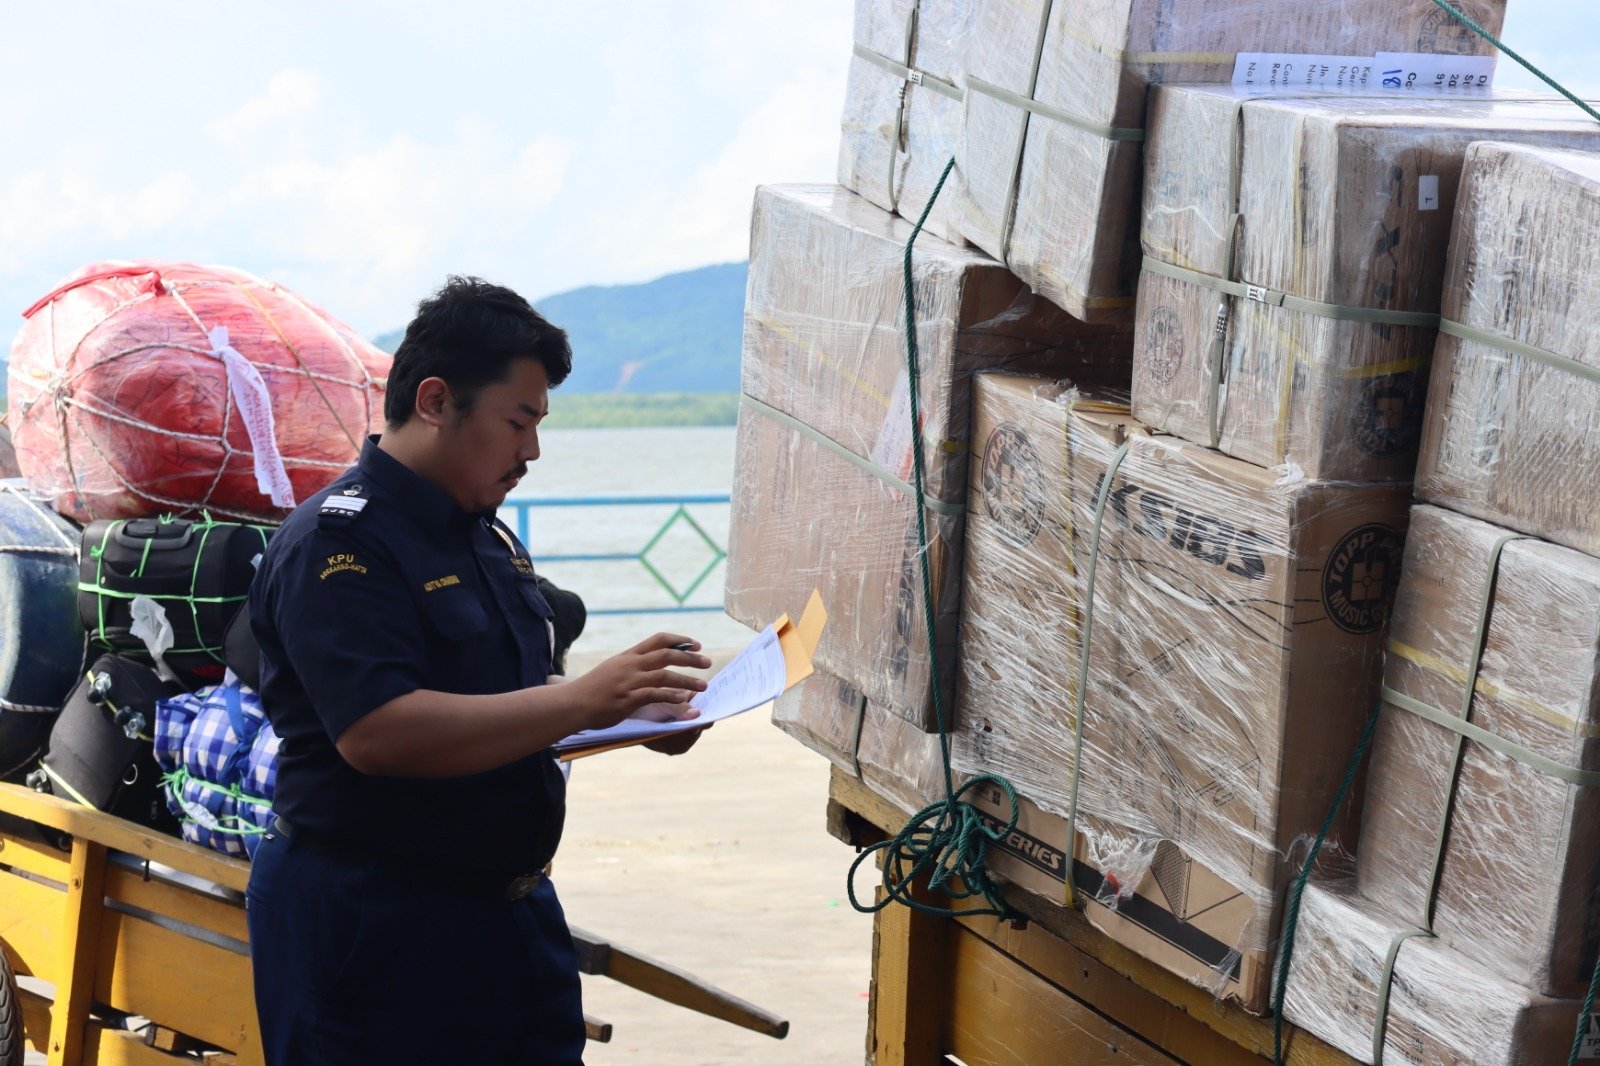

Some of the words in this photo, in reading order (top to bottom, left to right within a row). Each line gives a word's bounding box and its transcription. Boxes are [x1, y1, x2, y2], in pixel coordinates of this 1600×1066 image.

[327, 554, 354, 566] KPU
[1329, 531, 1375, 584] TOPP
[1330, 589, 1370, 626] MUSIC
